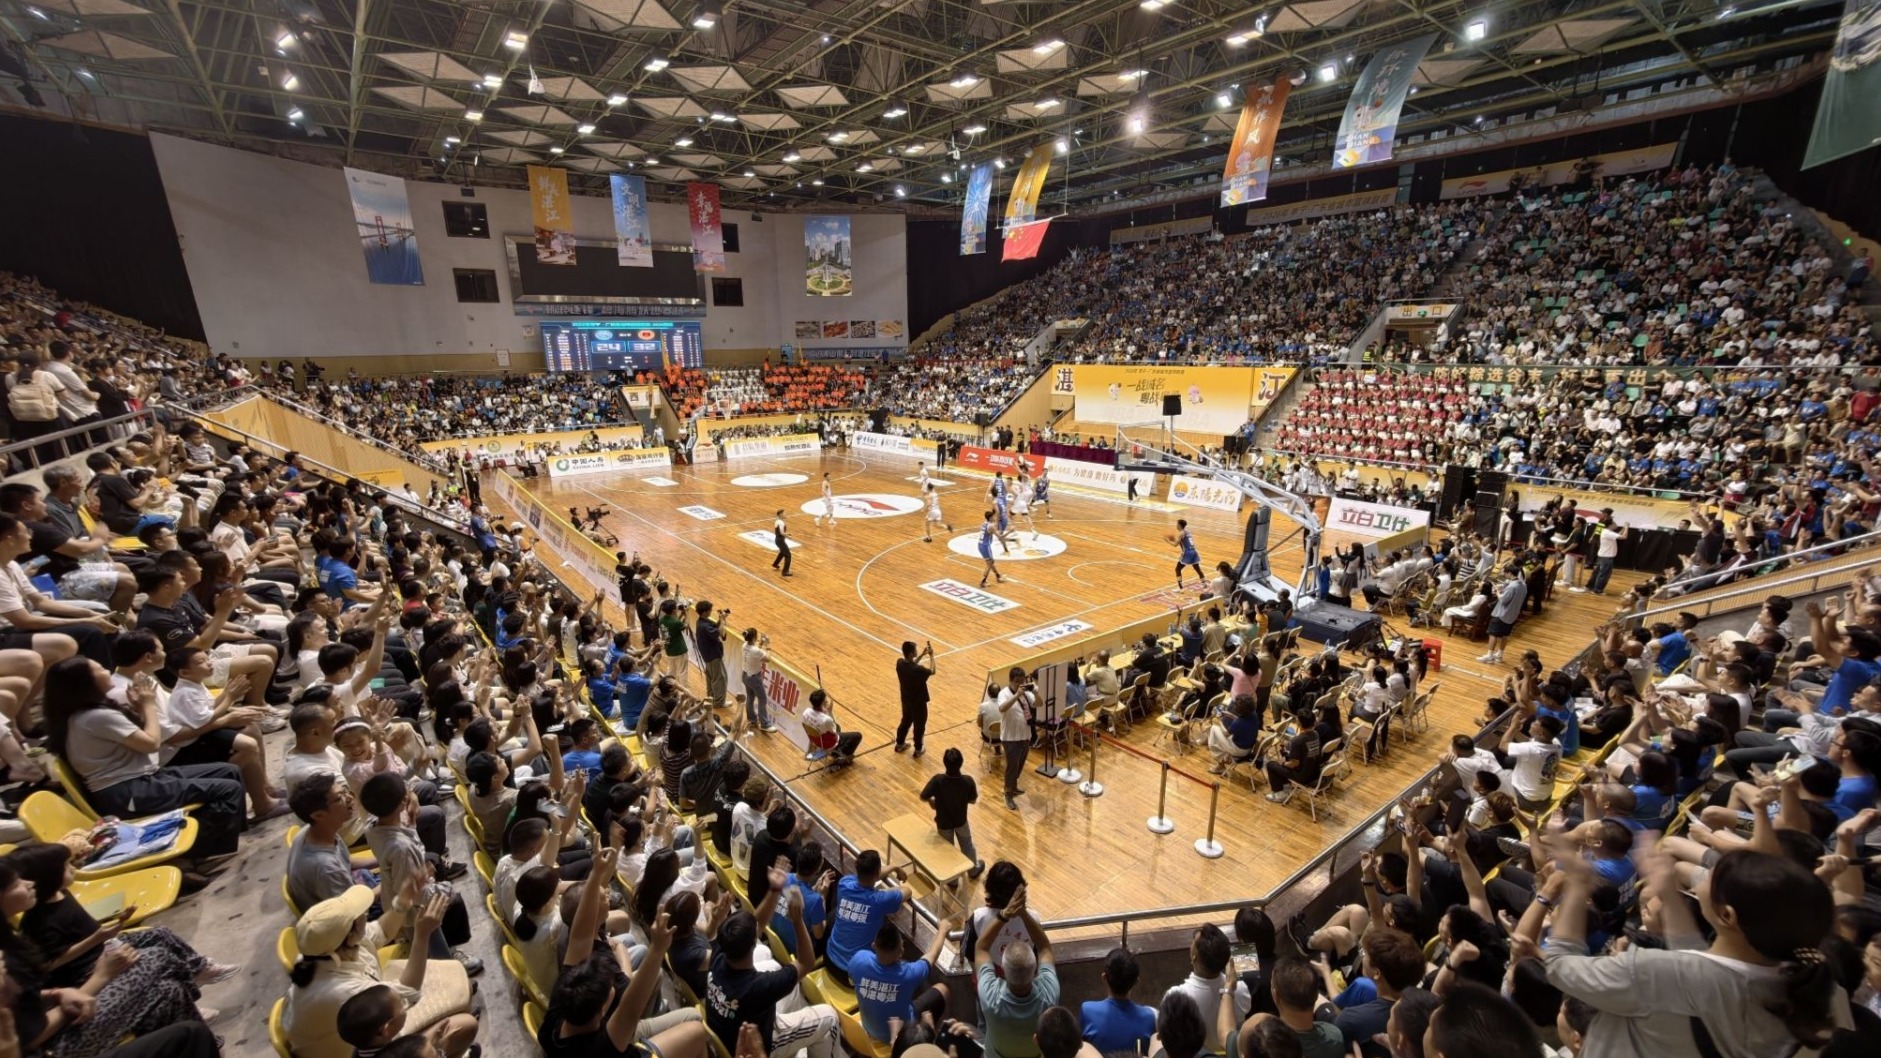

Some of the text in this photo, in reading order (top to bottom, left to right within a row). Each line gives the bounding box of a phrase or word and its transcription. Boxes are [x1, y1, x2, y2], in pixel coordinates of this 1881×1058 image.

[621, 182, 641, 231] 文明湛江
[597, 343, 621, 351] 24
[633, 343, 656, 351] 32
[1055, 368, 1074, 393] 湛
[1339, 507, 1411, 532] 立白卫仕
[929, 581, 1007, 611] 立白卫仕
[840, 898, 872, 914] 鲜美湛江
[861, 977, 900, 993] 鲜美湛江
